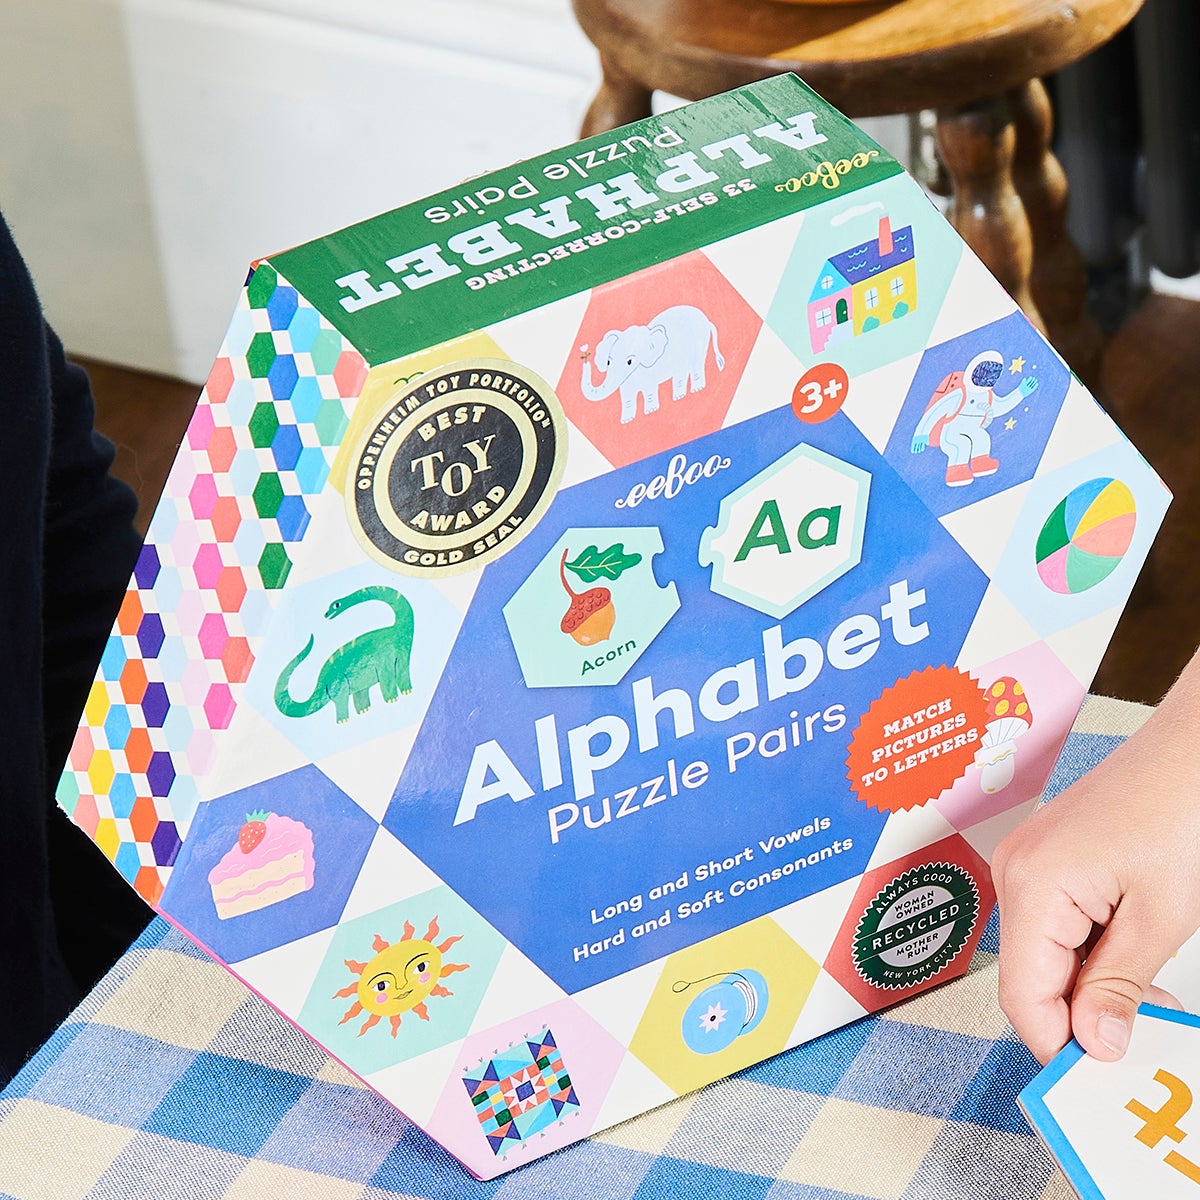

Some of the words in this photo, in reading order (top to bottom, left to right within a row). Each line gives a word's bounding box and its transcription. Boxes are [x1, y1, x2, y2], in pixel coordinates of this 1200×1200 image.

[542, 126, 684, 181] Puzzle
[424, 175, 539, 224] Pairs
[722, 178, 757, 197] 33
[335, 111, 829, 314] ALPHABET
[465, 192, 719, 290] SELF-CORRECTING
[799, 379, 843, 414] 3+
[357, 394, 422, 491] OPPENHEIM
[425, 375, 461, 399] TOY
[417, 405, 487, 442] BEST
[410, 434, 497, 497] TOY
[410, 485, 507, 532] AWARD
[733, 499, 843, 564] Aa
[403, 549, 464, 567] GOLD
[473, 515, 523, 555] SEAL
[580, 640, 637, 676] Acorn
[452, 579, 931, 828] Alphabet
[883, 698, 952, 738] MATCH
[861, 767, 888, 787] TO
[893, 728, 978, 775] LETTERS
[871, 713, 967, 764] PICTURES
[546, 759, 710, 846] Puzzle
[725, 703, 848, 774] Pairs
[590, 893, 643, 925] Long
[649, 872, 689, 901] and
[694, 846, 754, 882] Short
[758, 816, 832, 854] Vowels
[875, 877, 919, 915] ALWAYS
[922, 872, 953, 885] GOOD
[572, 929, 625, 963] Hard
[631, 910, 672, 939] and
[677, 890, 724, 920] Soft
[729, 837, 854, 898] Consonants
[894, 890, 934, 913] WOMAN
[896, 898, 934, 920] OWNED
[872, 904, 960, 951] RECYCLED
[896, 932, 939, 956] MOTHER
[907, 944, 929, 959] RUN
[882, 969, 903, 979] NEW
[906, 963, 932, 978] YORK
[934, 943, 953, 963] CITY
